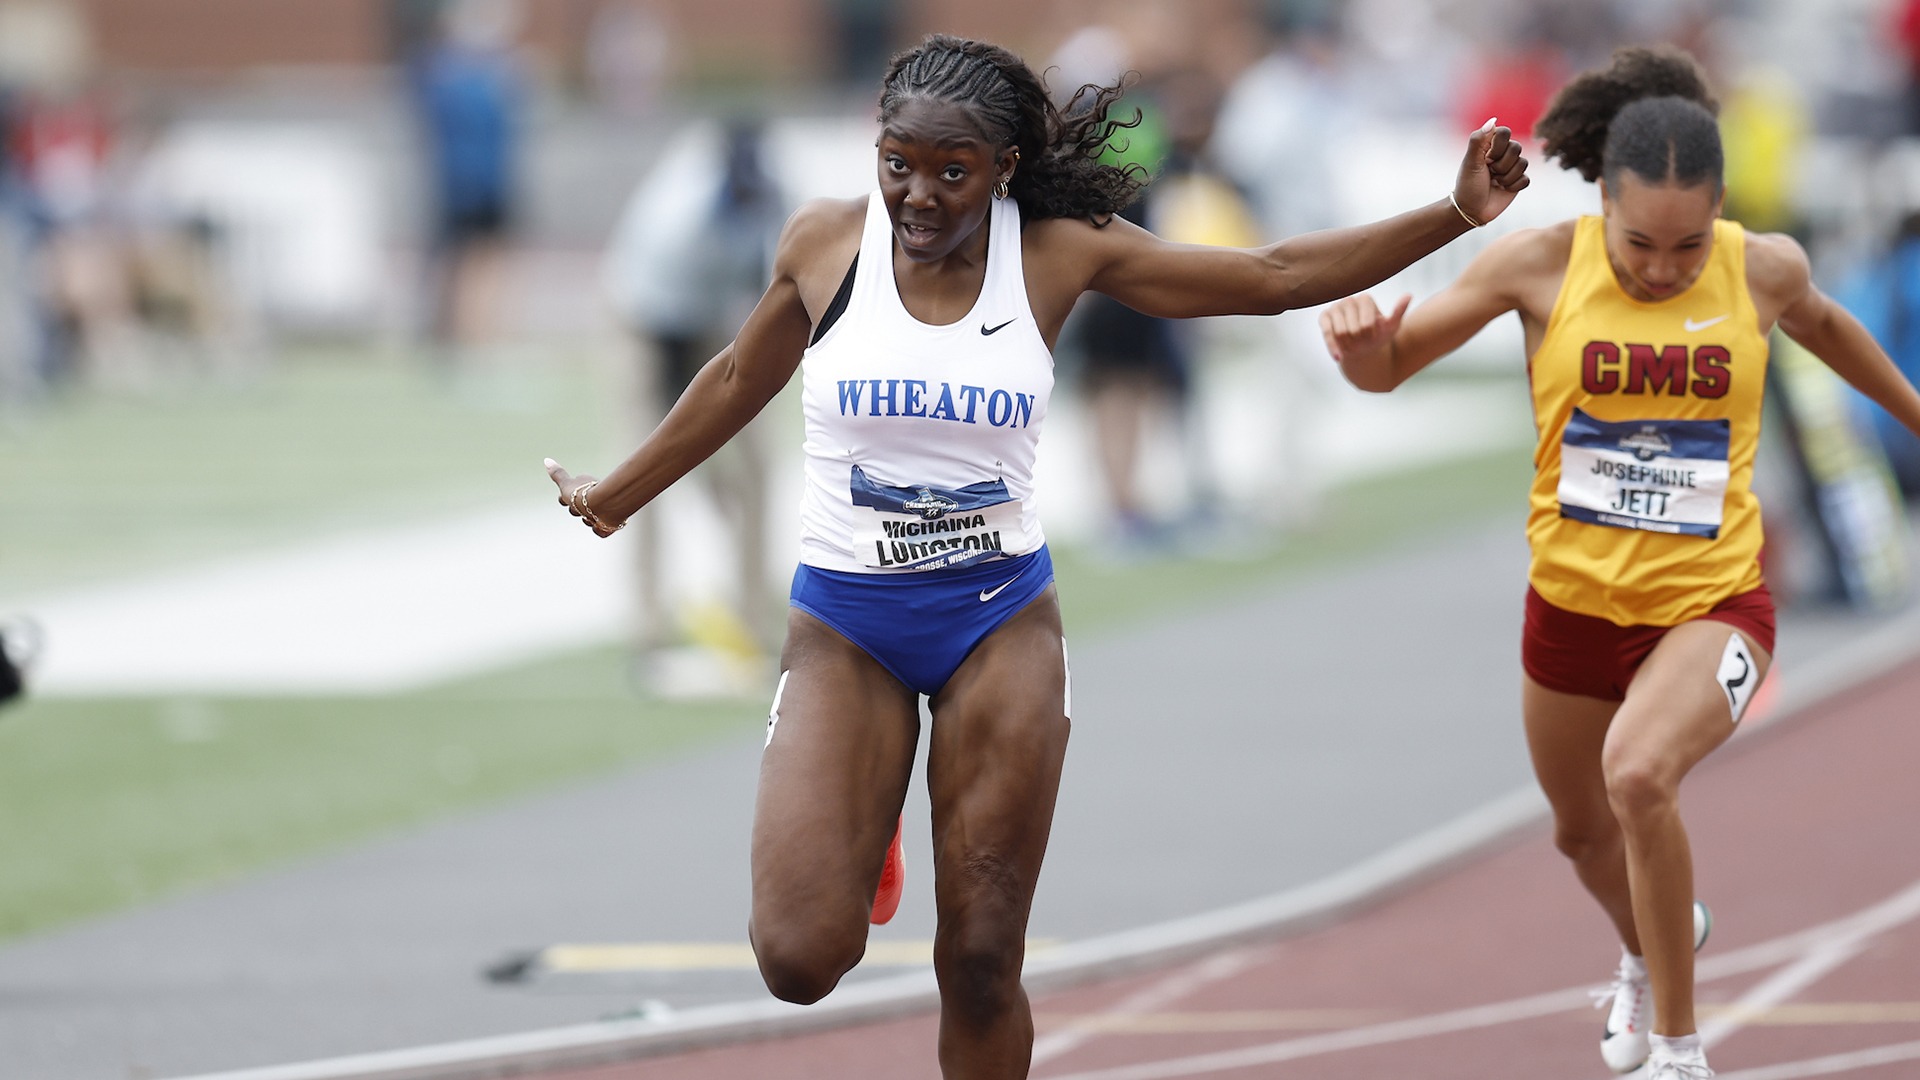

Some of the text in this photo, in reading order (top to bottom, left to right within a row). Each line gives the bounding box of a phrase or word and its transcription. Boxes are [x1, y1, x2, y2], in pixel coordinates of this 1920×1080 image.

[1582, 341, 1731, 399] CMS
[837, 379, 1035, 429] WHEATON
[1591, 459, 1696, 488] JOSEPHINE
[1612, 488, 1671, 516] JETT
[882, 514, 986, 538] MICHAINA
[1727, 651, 1749, 706] 2
